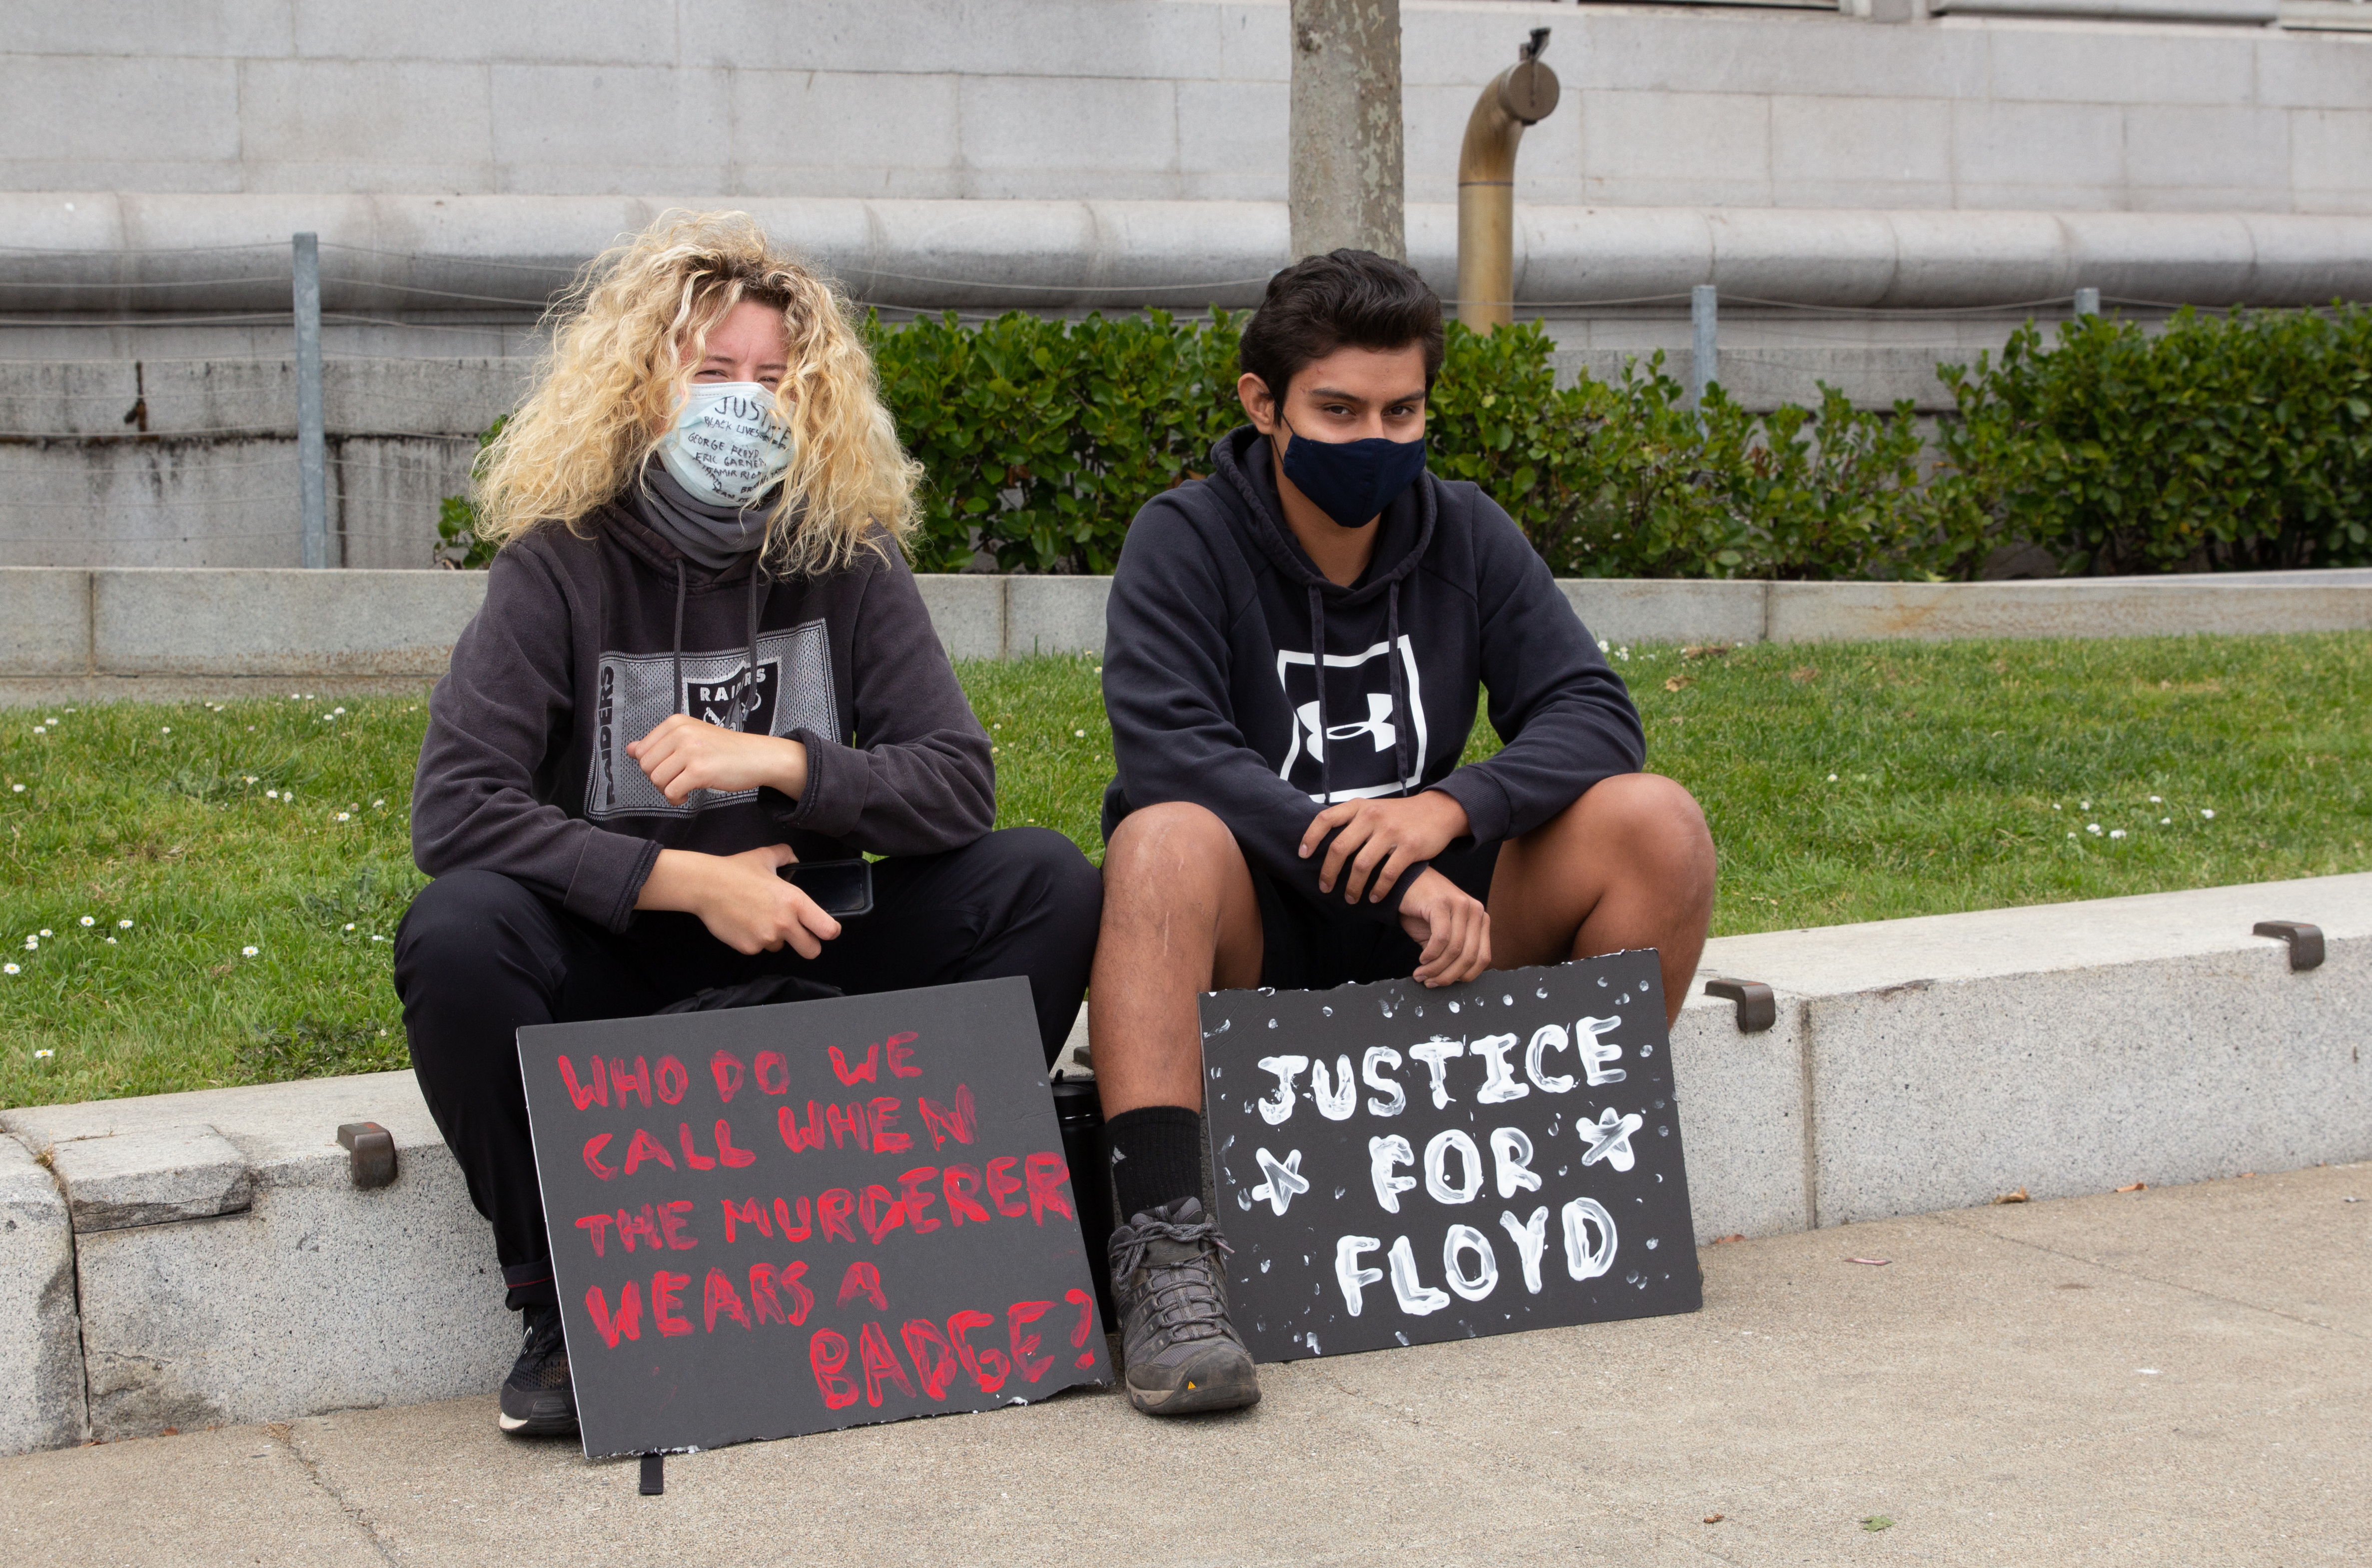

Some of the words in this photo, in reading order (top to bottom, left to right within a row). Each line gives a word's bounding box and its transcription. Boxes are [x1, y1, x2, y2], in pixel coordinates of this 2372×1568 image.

[688, 432, 725, 451] GEORGE
[731, 445, 759, 458] FLOYD
[696, 452, 718, 464] ERIC
[724, 456, 766, 468] GARNER
[704, 416, 732, 431] BLACK
[737, 425, 759, 437] LIVES
[709, 467, 737, 477] TAMIR
[701, 668, 766, 702] RAIDRS
[600, 666, 615, 805] RAIDERS
[558, 1055, 689, 1111] WHO
[711, 1050, 791, 1103] DO
[828, 1032, 922, 1087] WE
[1258, 1015, 1626, 1125] JUSTICE
[583, 1119, 757, 1181] CALL
[778, 1084, 976, 1155] WHEN
[1368, 1127, 1542, 1214] FOR
[575, 1200, 699, 1257] THE
[721, 1152, 1072, 1245] MURDERER
[1335, 1197, 1618, 1317] FLOYD
[584, 1260, 814, 1349] WEARS
[836, 1261, 887, 1310] A
[809, 1288, 1095, 1410] BADGE?
